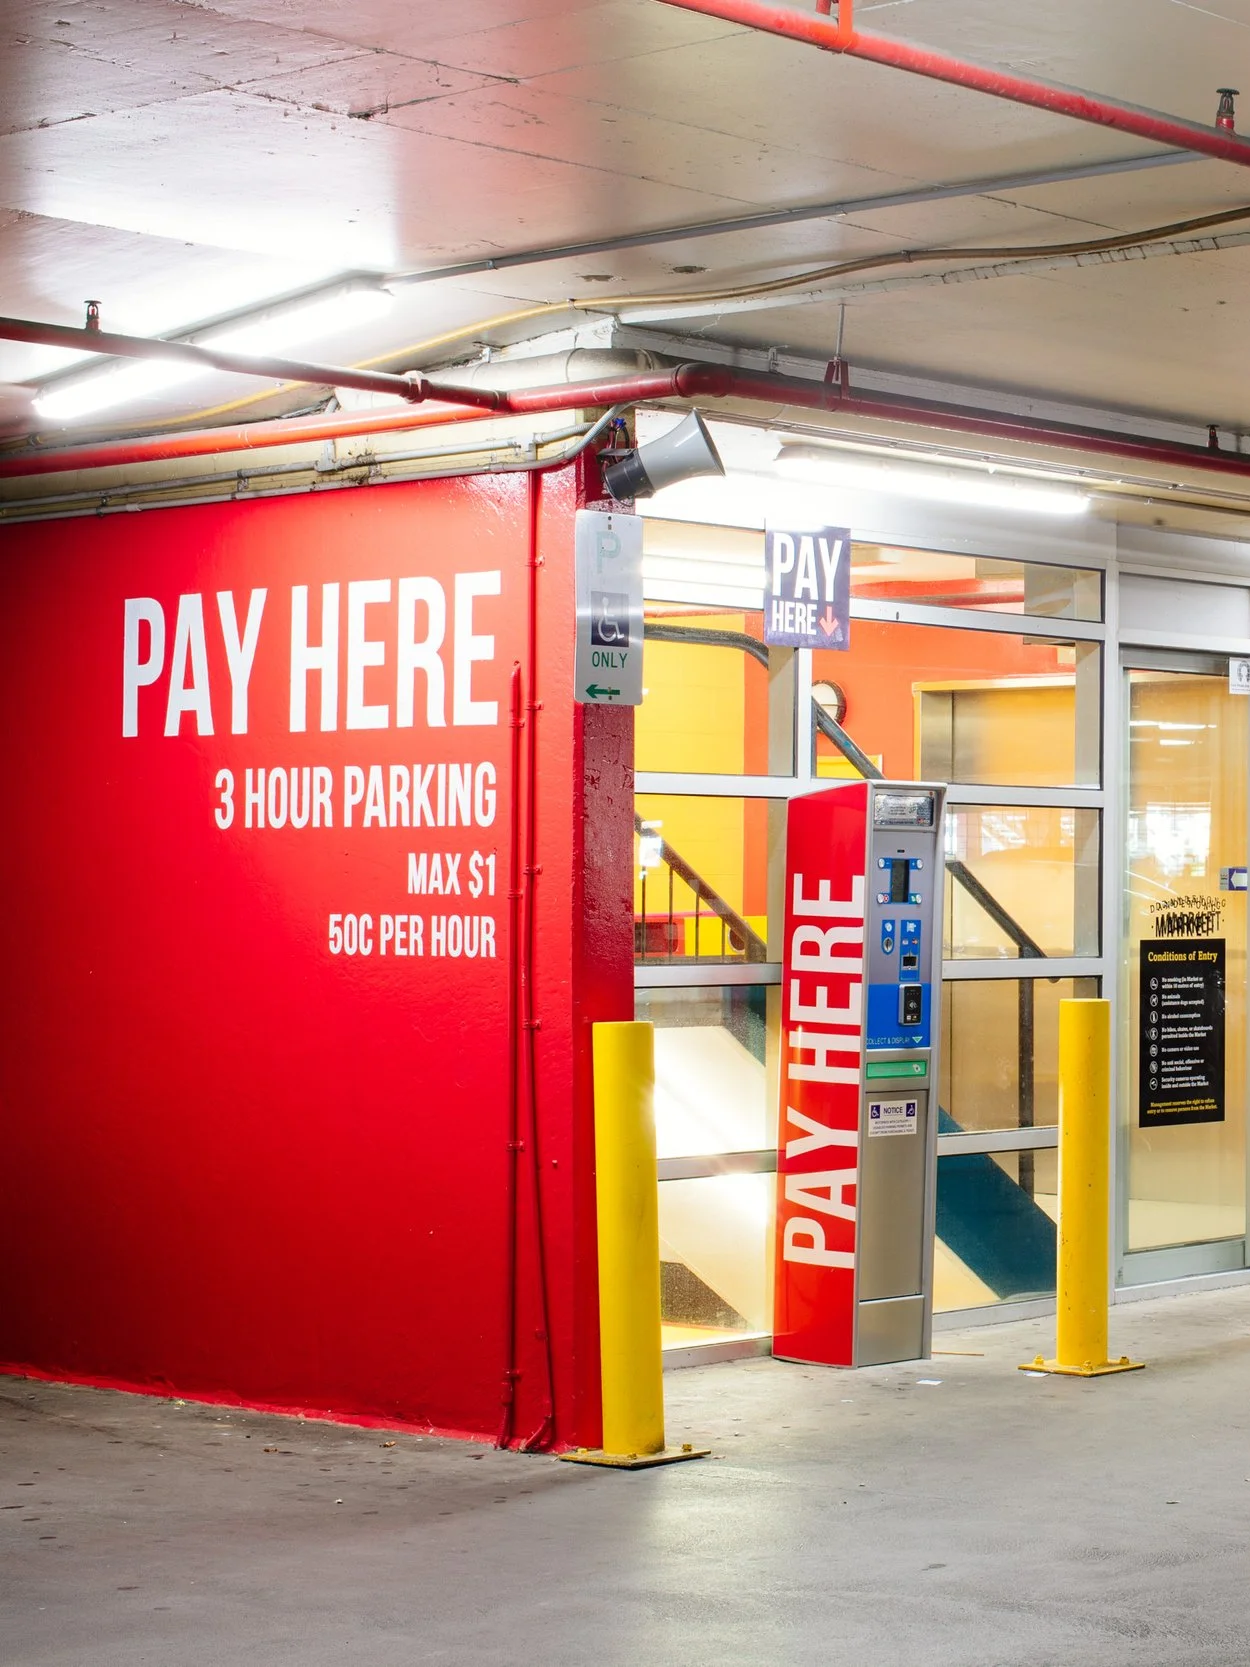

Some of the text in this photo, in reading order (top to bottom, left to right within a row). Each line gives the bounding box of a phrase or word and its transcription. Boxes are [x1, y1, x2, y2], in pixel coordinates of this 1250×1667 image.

[596, 531, 622, 575] P
[772, 532, 842, 602] PAY
[771, 601, 817, 636] HERE
[122, 570, 501, 738] PAY HERE
[592, 651, 628, 669] ONLY
[214, 761, 496, 830] 3 HOUR PARKING
[407, 850, 496, 899] MAX $1
[328, 913, 496, 958] 50C PER HOUR
[1148, 951, 1218, 963] Conditions of Entry
[783, 873, 865, 1270] PAY HERE
[884, 1106, 903, 1114] NOTICE
